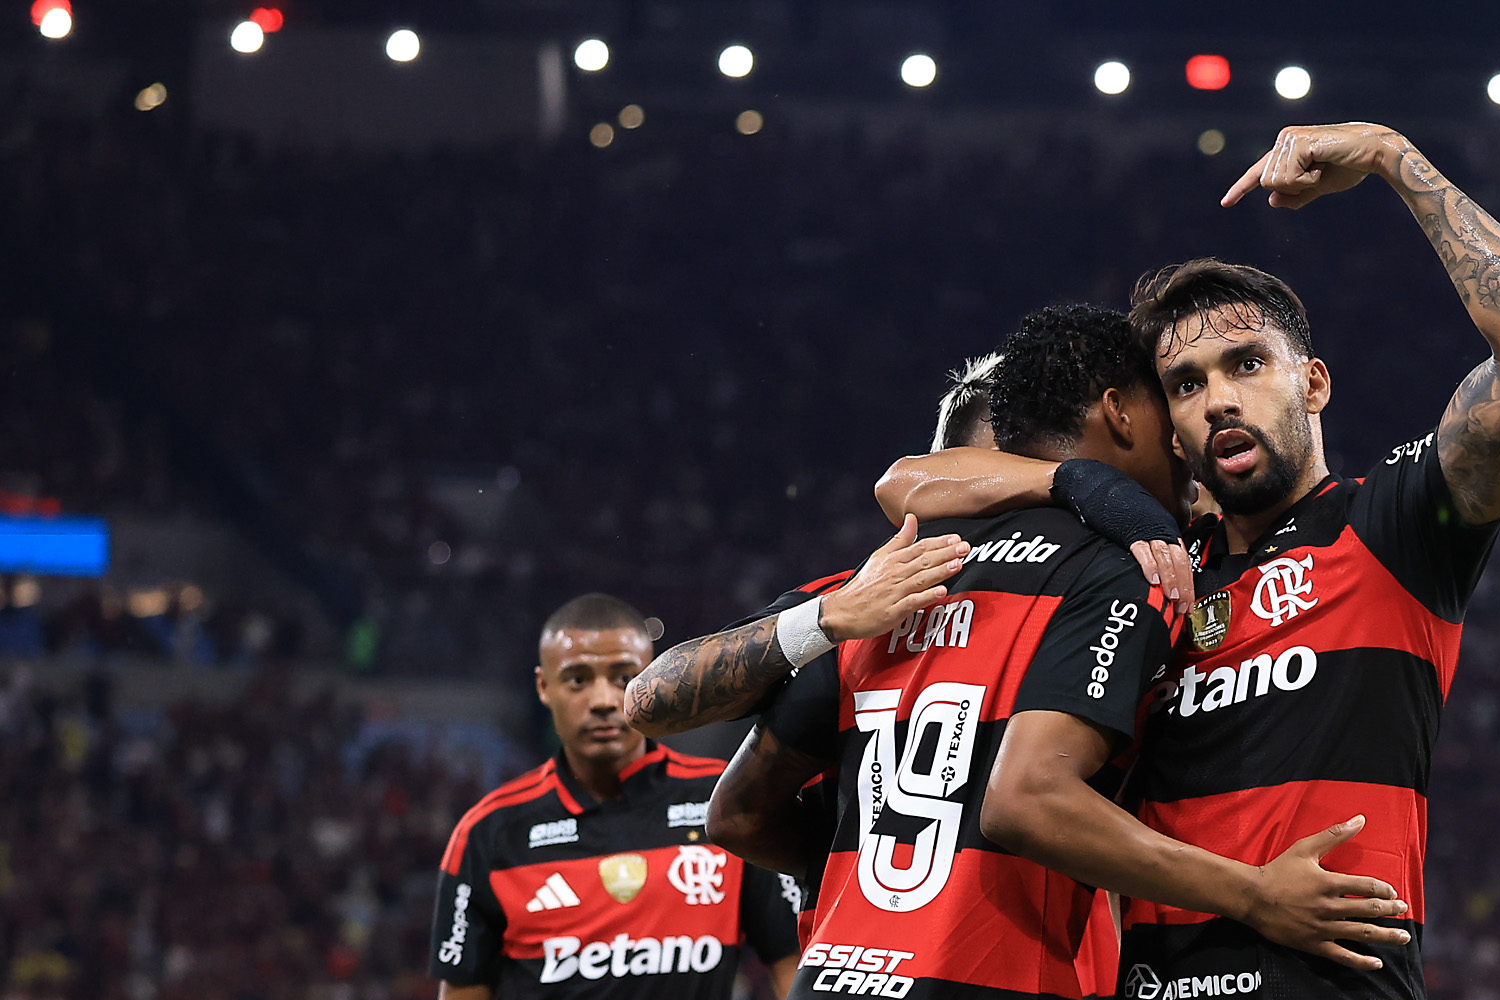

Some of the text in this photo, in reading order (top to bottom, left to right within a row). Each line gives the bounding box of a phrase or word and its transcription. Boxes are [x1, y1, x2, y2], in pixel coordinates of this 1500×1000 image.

[961, 531, 1062, 565] vida
[887, 599, 975, 654] PLATA
[1086, 599, 1138, 700] Shopee
[946, 698, 971, 762] TEXACO
[853, 681, 987, 913] 19
[438, 882, 472, 967] Shopee
[539, 932, 723, 984] Betano
[812, 968, 915, 1000] CARD
